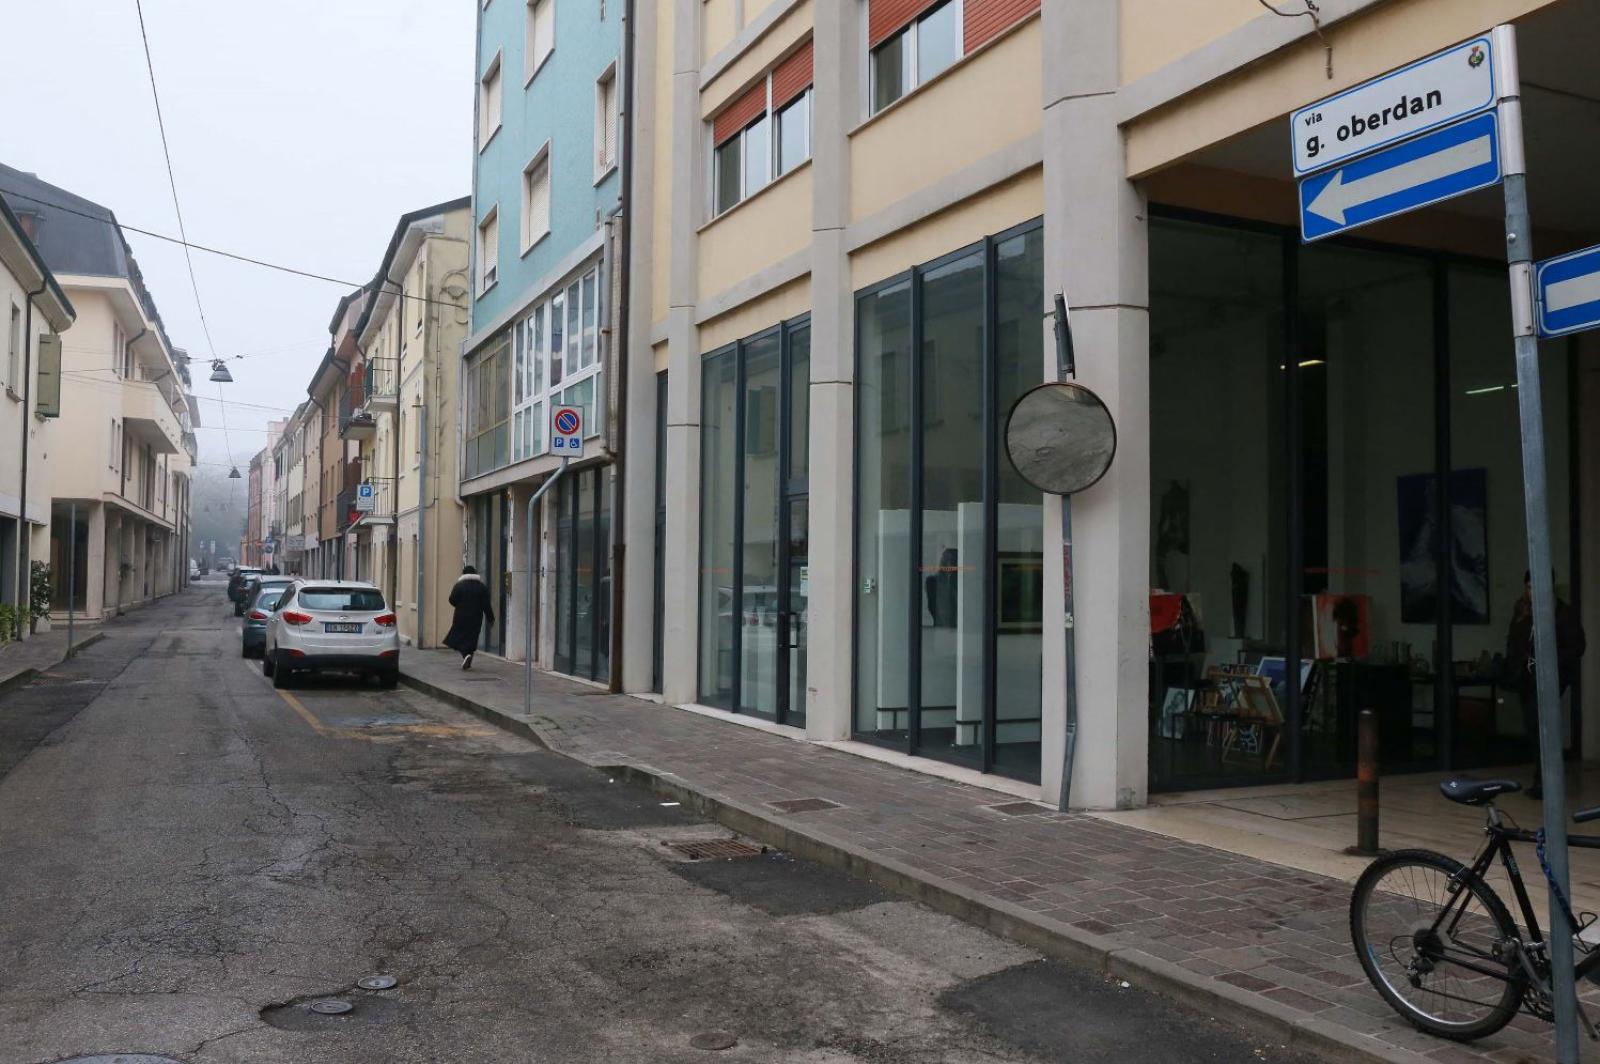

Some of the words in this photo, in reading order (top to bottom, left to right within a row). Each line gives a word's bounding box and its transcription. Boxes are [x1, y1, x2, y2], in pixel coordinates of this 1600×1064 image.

[1304, 112, 1323, 127] via
[1306, 135, 1326, 157] g.
[1336, 89, 1442, 142] oberdan
[556, 438, 563, 447] P
[363, 487, 370, 496] P
